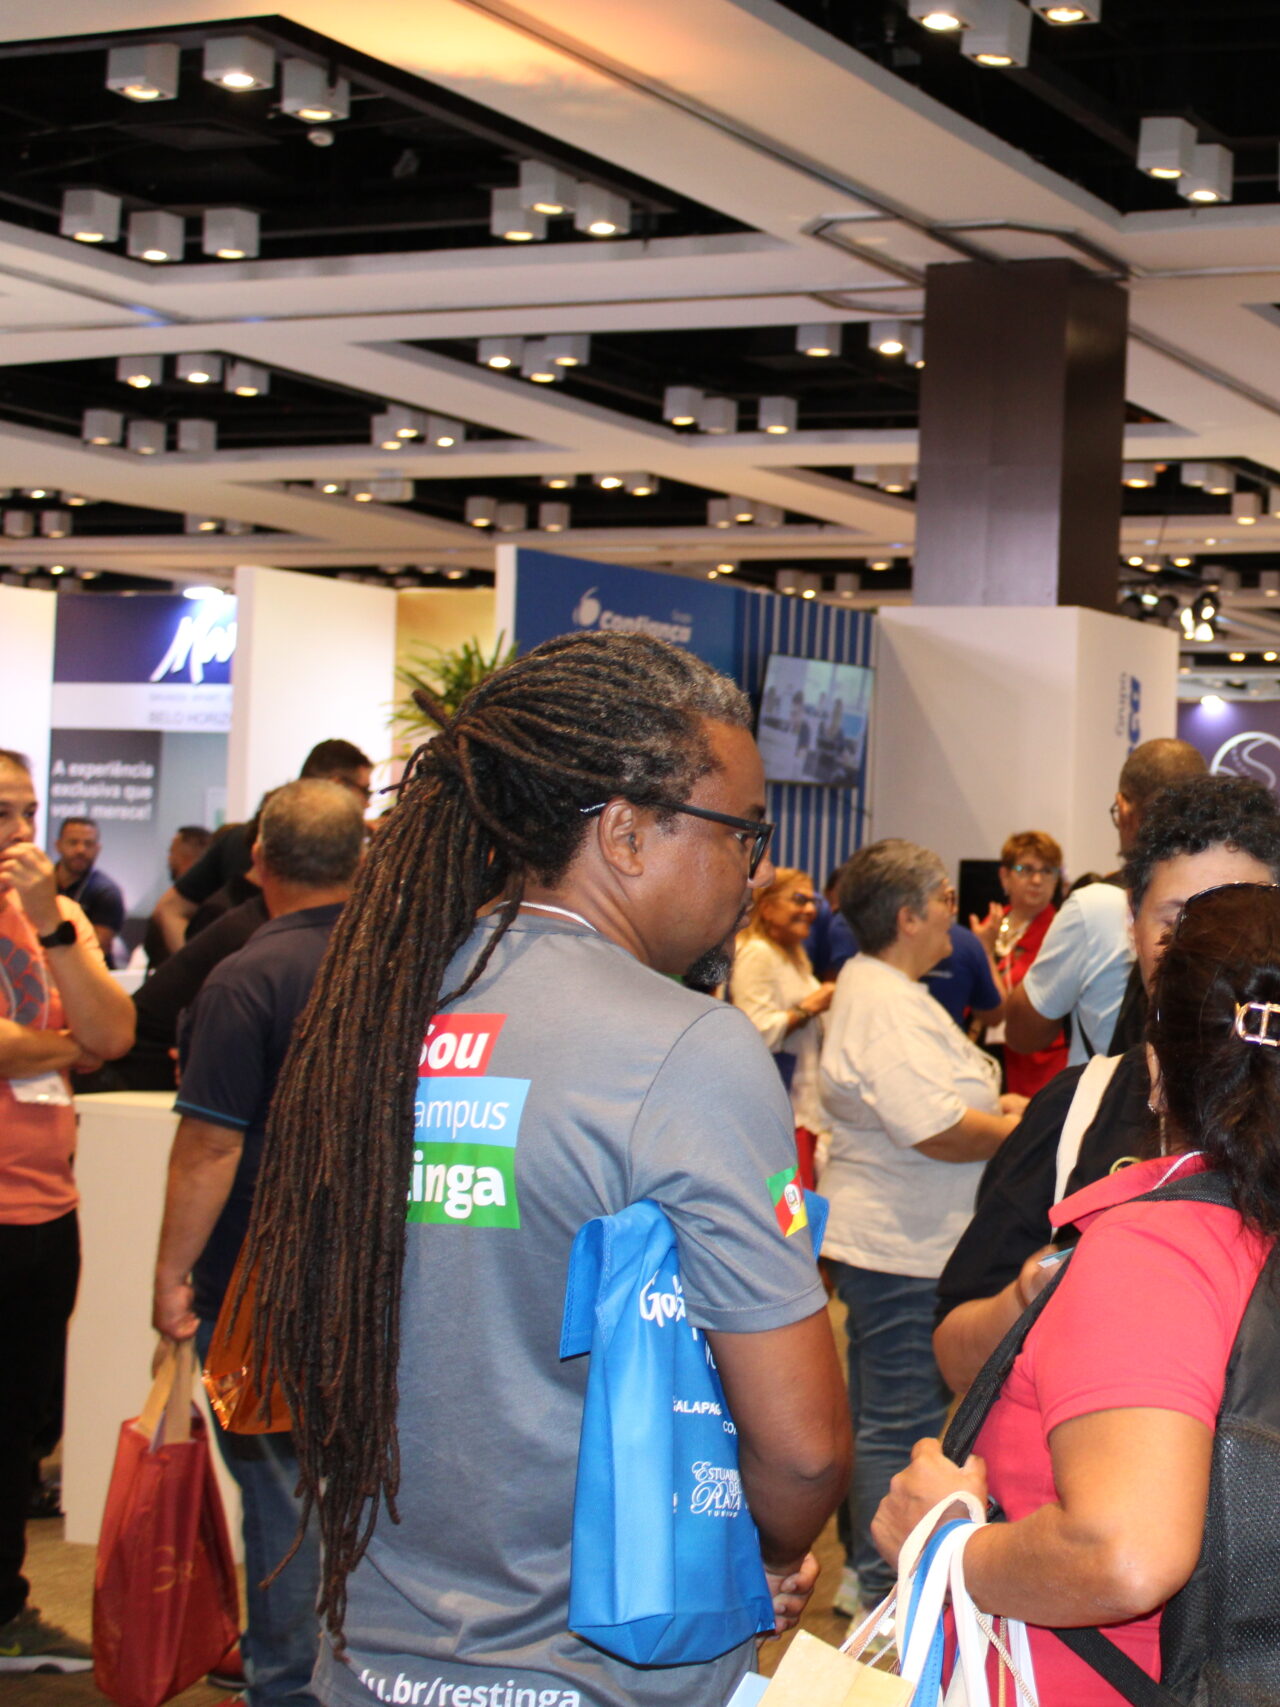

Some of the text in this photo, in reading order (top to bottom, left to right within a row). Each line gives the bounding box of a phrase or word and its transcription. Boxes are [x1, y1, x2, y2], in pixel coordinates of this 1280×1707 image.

[52, 760, 154, 779] A experiência
[51, 782, 153, 802] exclusiva que
[414, 1099, 510, 1139] ampus
[406, 1150, 507, 1219] inga
[358, 1669, 581, 1707] u.br/restinga
